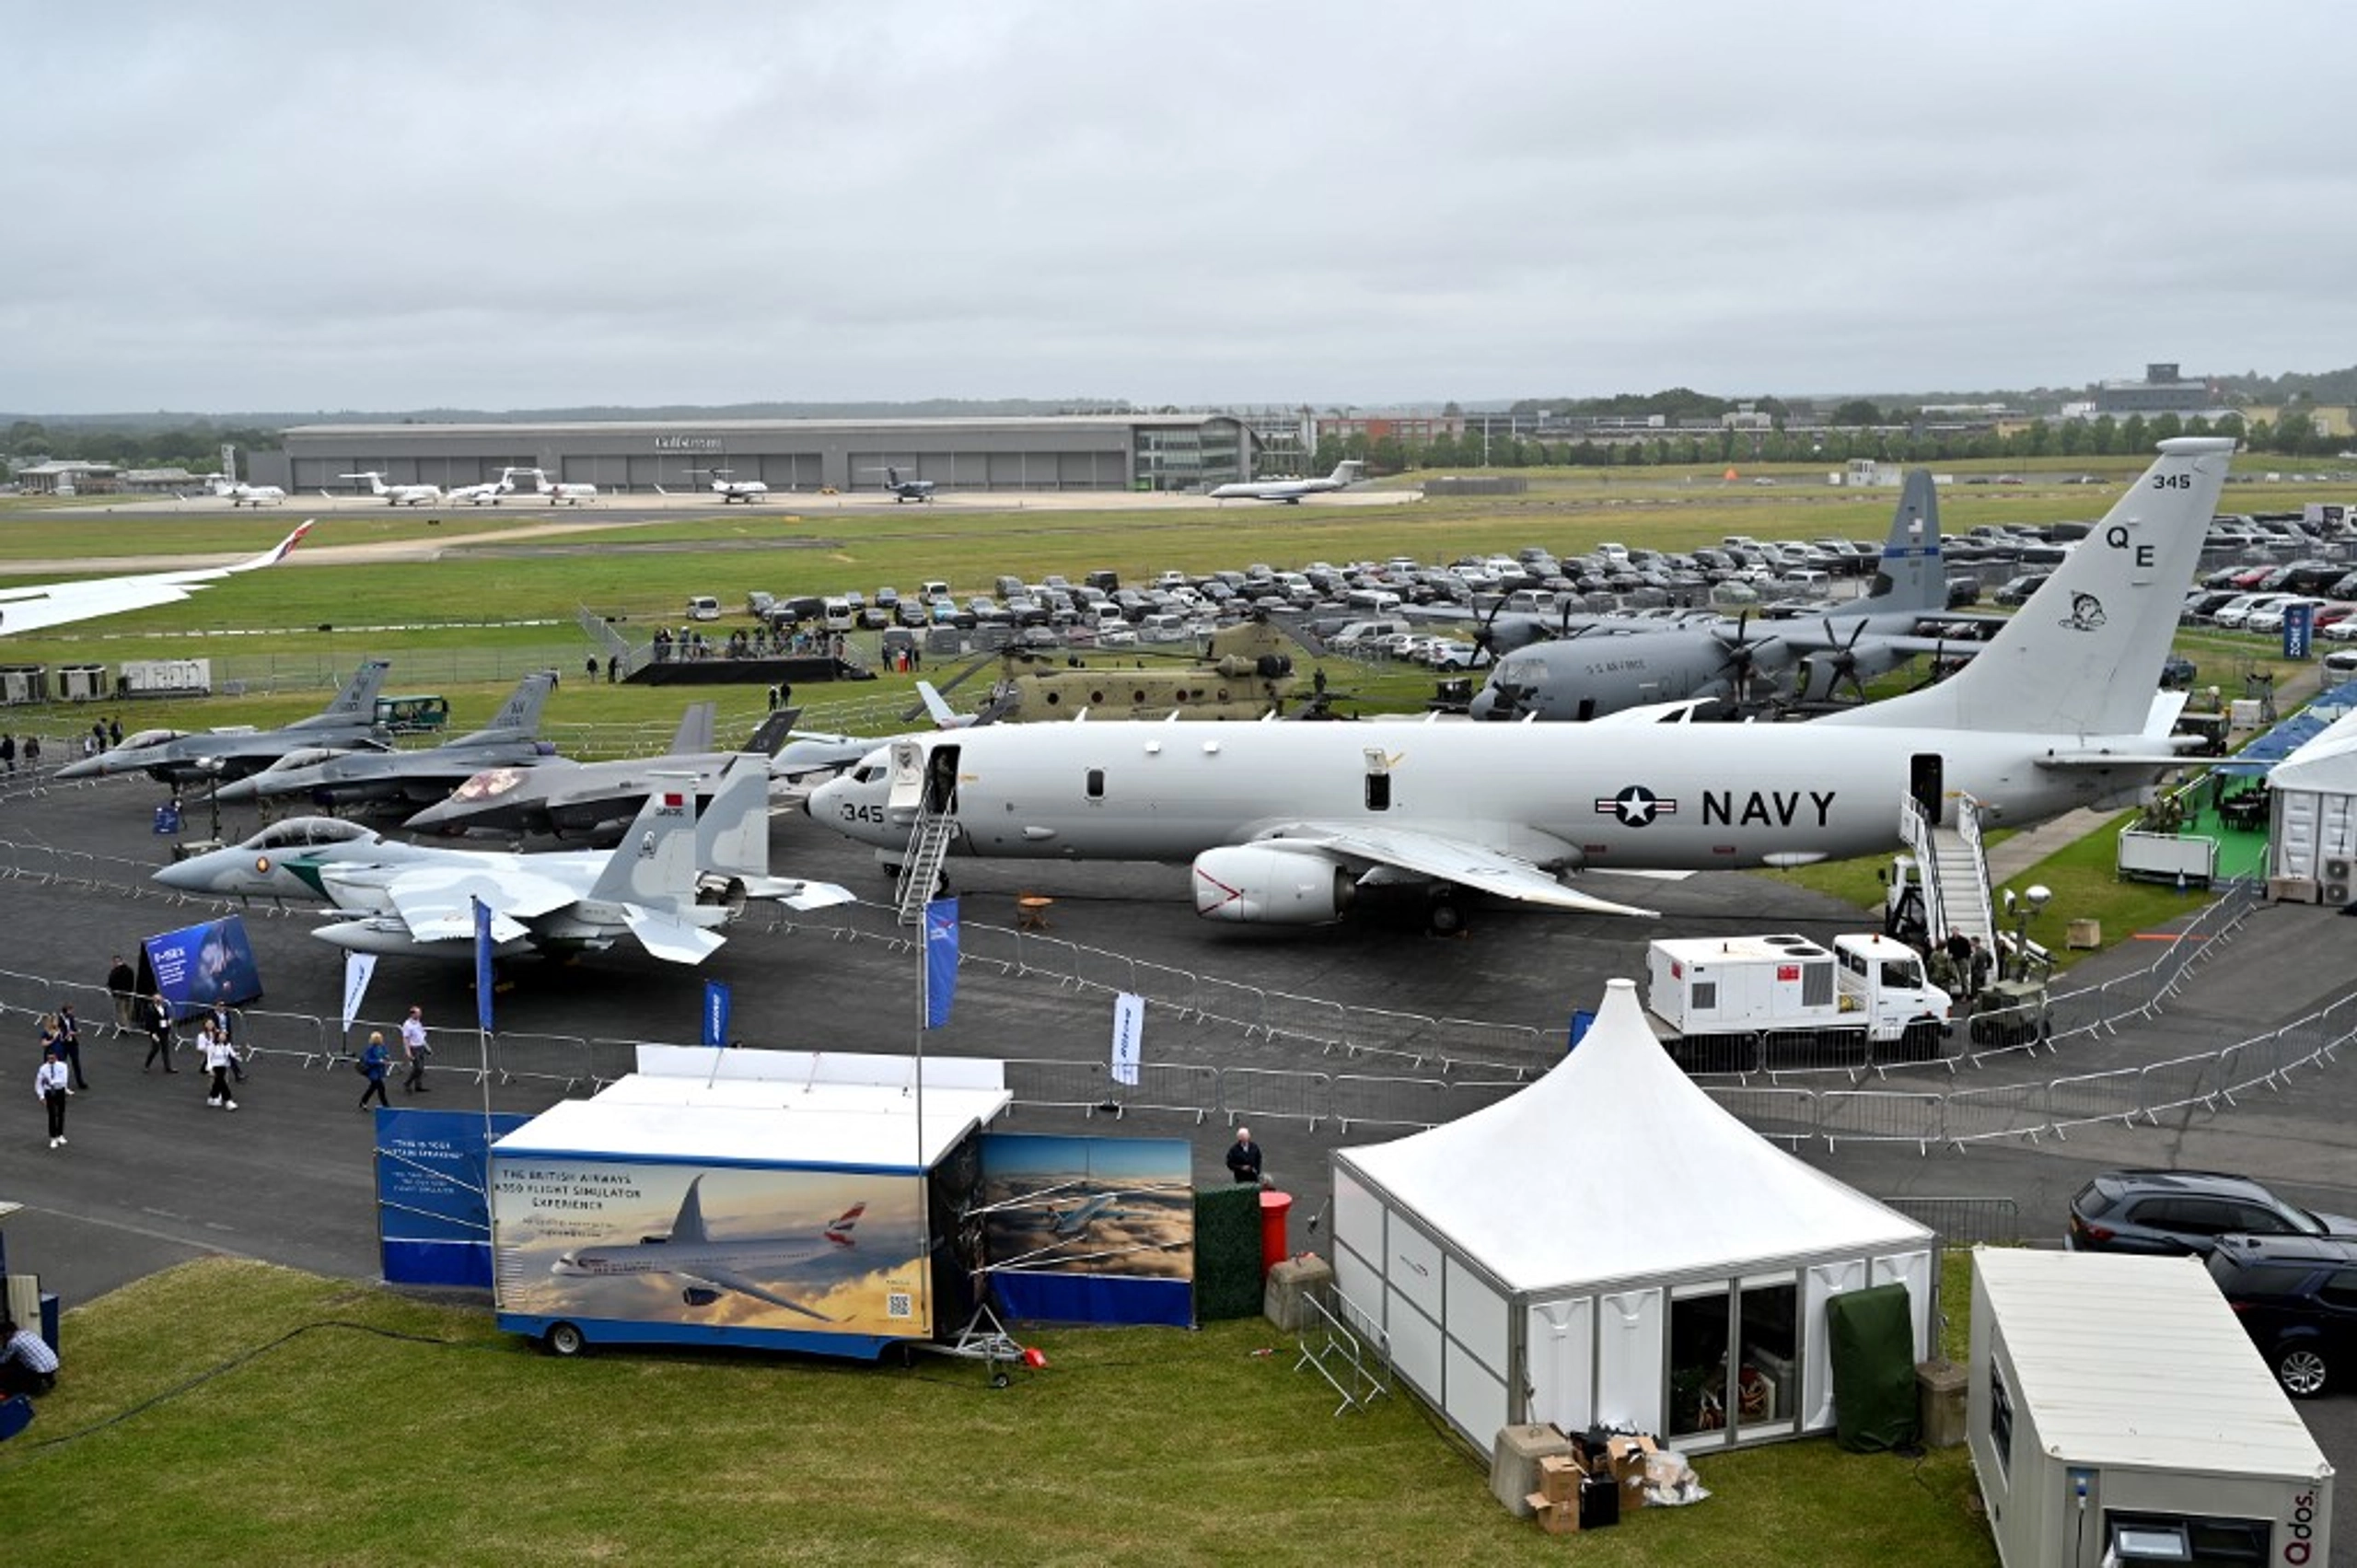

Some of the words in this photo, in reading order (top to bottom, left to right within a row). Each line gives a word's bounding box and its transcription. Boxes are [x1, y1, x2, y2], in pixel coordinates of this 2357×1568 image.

[2153, 474, 2190, 490] 345
[2106, 526, 2130, 550] Q
[2135, 545, 2155, 567] E
[842, 803, 885, 823] 345
[1703, 791, 1836, 827] NAVY
[502, 1169, 526, 1180] THE
[528, 1170, 575, 1183] BRITISH
[579, 1173, 632, 1185] AIRWAYS
[527, 1184, 568, 1196] FLIGHT
[573, 1186, 642, 1199] SIMULATOR
